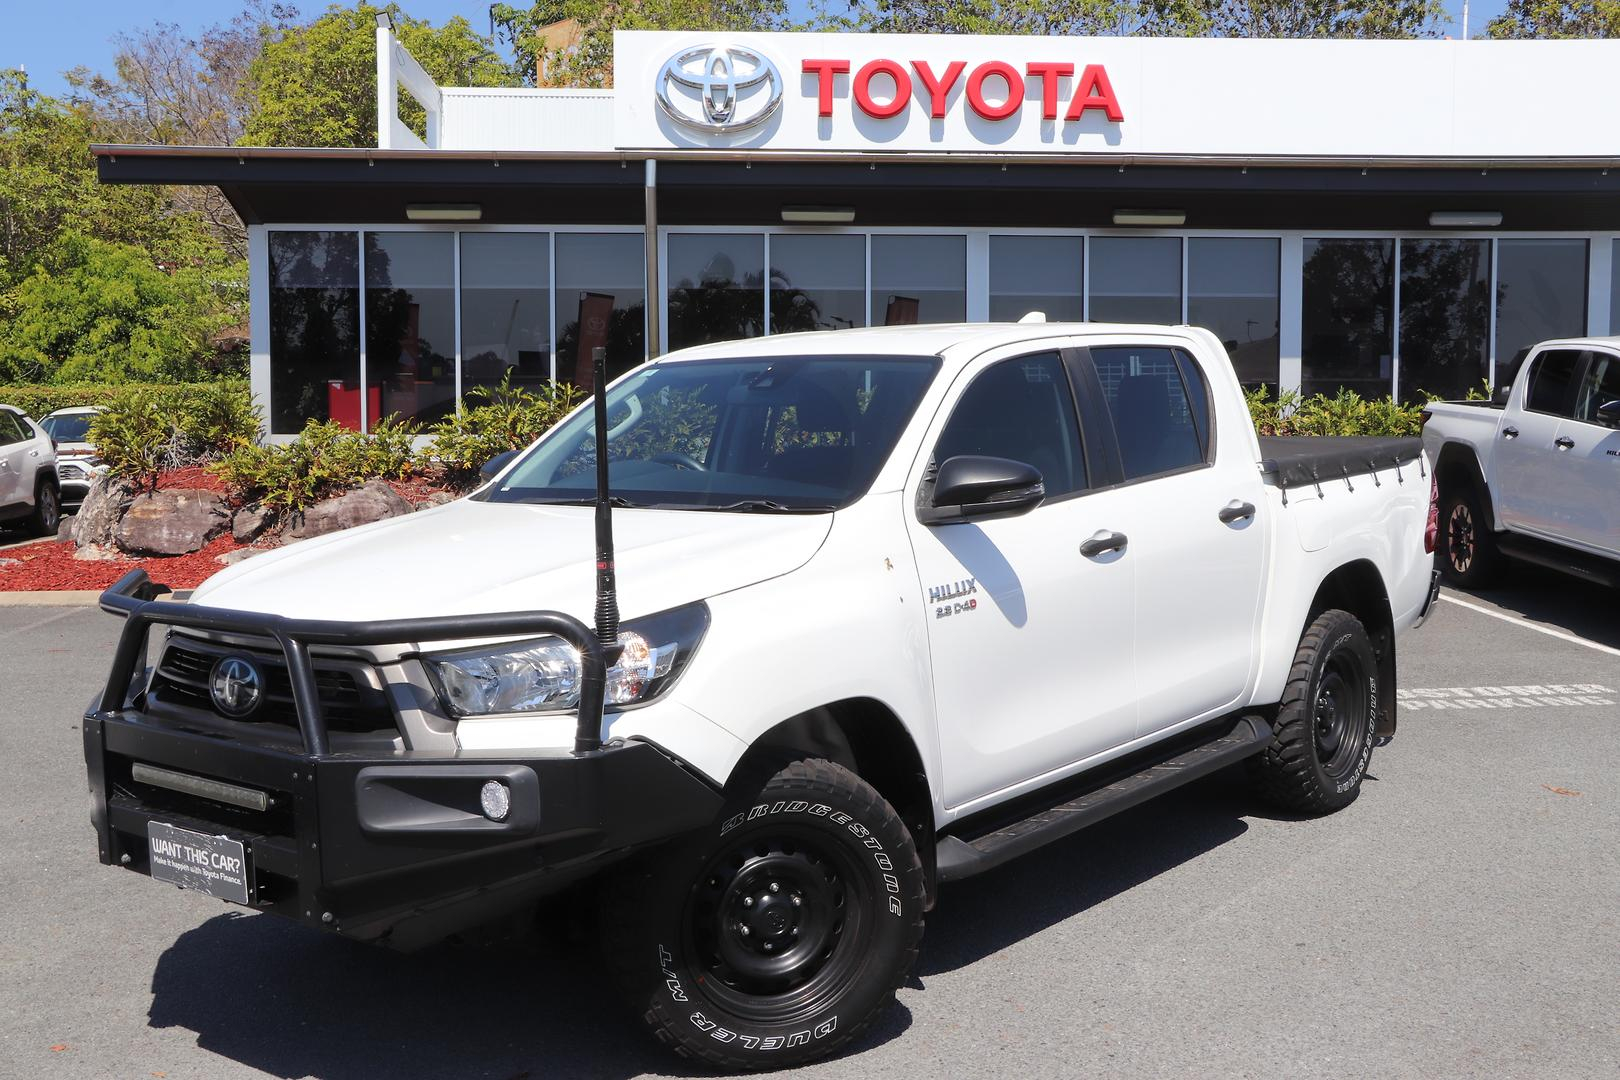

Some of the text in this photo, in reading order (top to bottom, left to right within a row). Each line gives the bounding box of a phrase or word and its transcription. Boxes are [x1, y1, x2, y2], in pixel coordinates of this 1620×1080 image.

[802, 58, 1124, 122] TOYOTA
[928, 577, 977, 603] HILUX
[152, 838, 240, 873] WANT THIS CAR?
[154, 855, 167, 865] Make
[172, 860, 189, 871] happen
[190, 866, 202, 874] with
[202, 868, 219, 880] Toyota
[720, 801, 901, 917] BRIDGESTONE
[658, 944, 838, 1051] DUELER M/T
